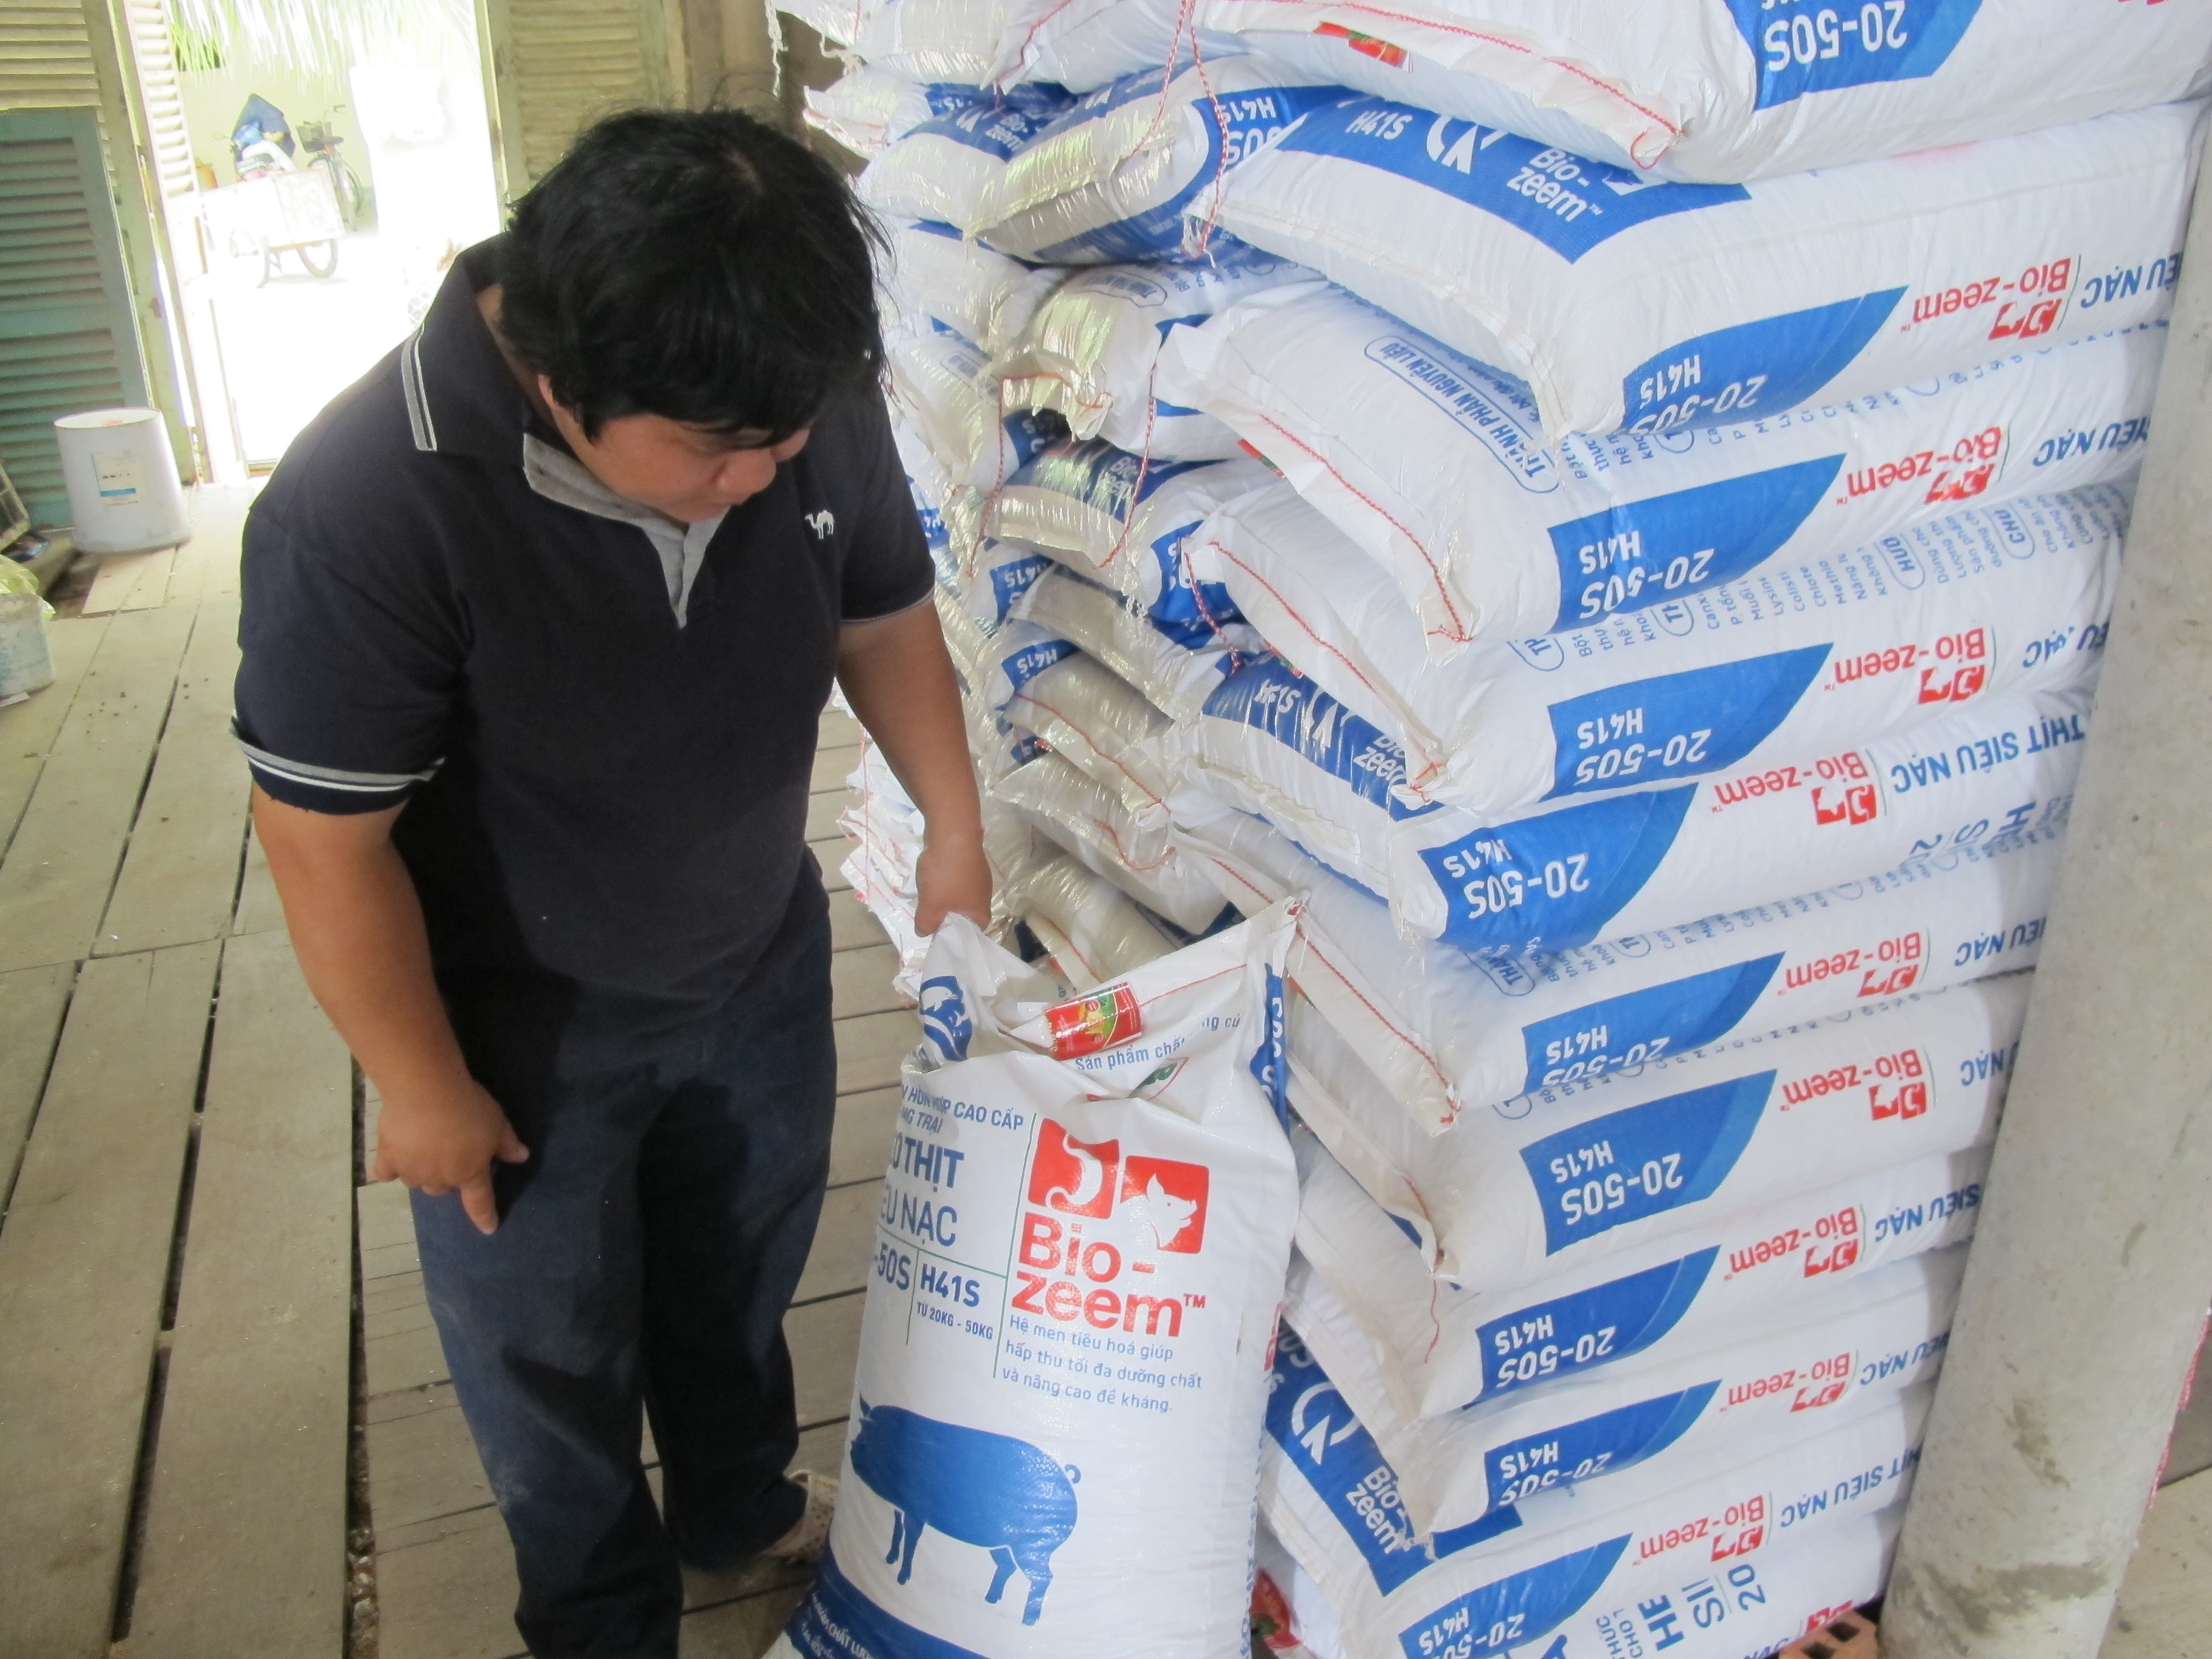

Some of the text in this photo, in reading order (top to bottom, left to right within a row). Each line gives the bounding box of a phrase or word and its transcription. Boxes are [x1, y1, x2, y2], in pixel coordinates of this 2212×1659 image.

[1764, 0, 1908, 72] 20-50S
[1638, 352, 1702, 410] H41S
[1578, 530, 1641, 574] H41S
[1579, 548, 1714, 618] 20-50S
[1016, 649, 1058, 674] H41S
[1577, 707, 1644, 749] H41S
[2027, 714, 2086, 753] THỊT
[1575, 729, 1712, 786] 20-50S
[1891, 754, 1951, 793] NẠC
[1956, 731, 2019, 774] SIÊU
[1443, 838, 1513, 877] H41S
[1463, 853, 1590, 919] 20-50S
[1955, 930, 2006, 967] NẠC
[1542, 1036, 1670, 1087] 20-50S
[1546, 1024, 1608, 1065] H41S
[1960, 1048, 2005, 1087] NẠC
[953, 1101, 987, 1123] CAO
[990, 1107, 1024, 1131] CẤP
[903, 1136, 965, 1193] THỊT
[1550, 1140, 1615, 1184] H41S
[1560, 1153, 1684, 1226] 20-50S
[900, 1193, 957, 1247] NẠC
[1874, 1204, 1923, 1242] NẠC
[920, 1263, 980, 1308] H41S
[930, 1307, 954, 1327] 20KG
[965, 1319, 994, 1340] 50KG
[1010, 1315, 1175, 1362] Hệ men tiêu hoá giúp
[1493, 1313, 1555, 1355] H41S
[1005, 1339, 1203, 1389] hấp thu tối đa dưỡng chất
[1495, 1325, 1617, 1389] 20-50S
[1860, 1353, 1909, 1385] NẠC
[1002, 1366, 1019, 1383] và
[1023, 1373, 1061, 1397] nâng
[1064, 1386, 1091, 1401] cao
[1499, 1441, 1559, 1479] H41S
[1832, 1464, 1883, 1505] SIÊU
[1780, 1490, 1828, 1528] NẠC
[1418, 1607, 1469, 1656] H41S
